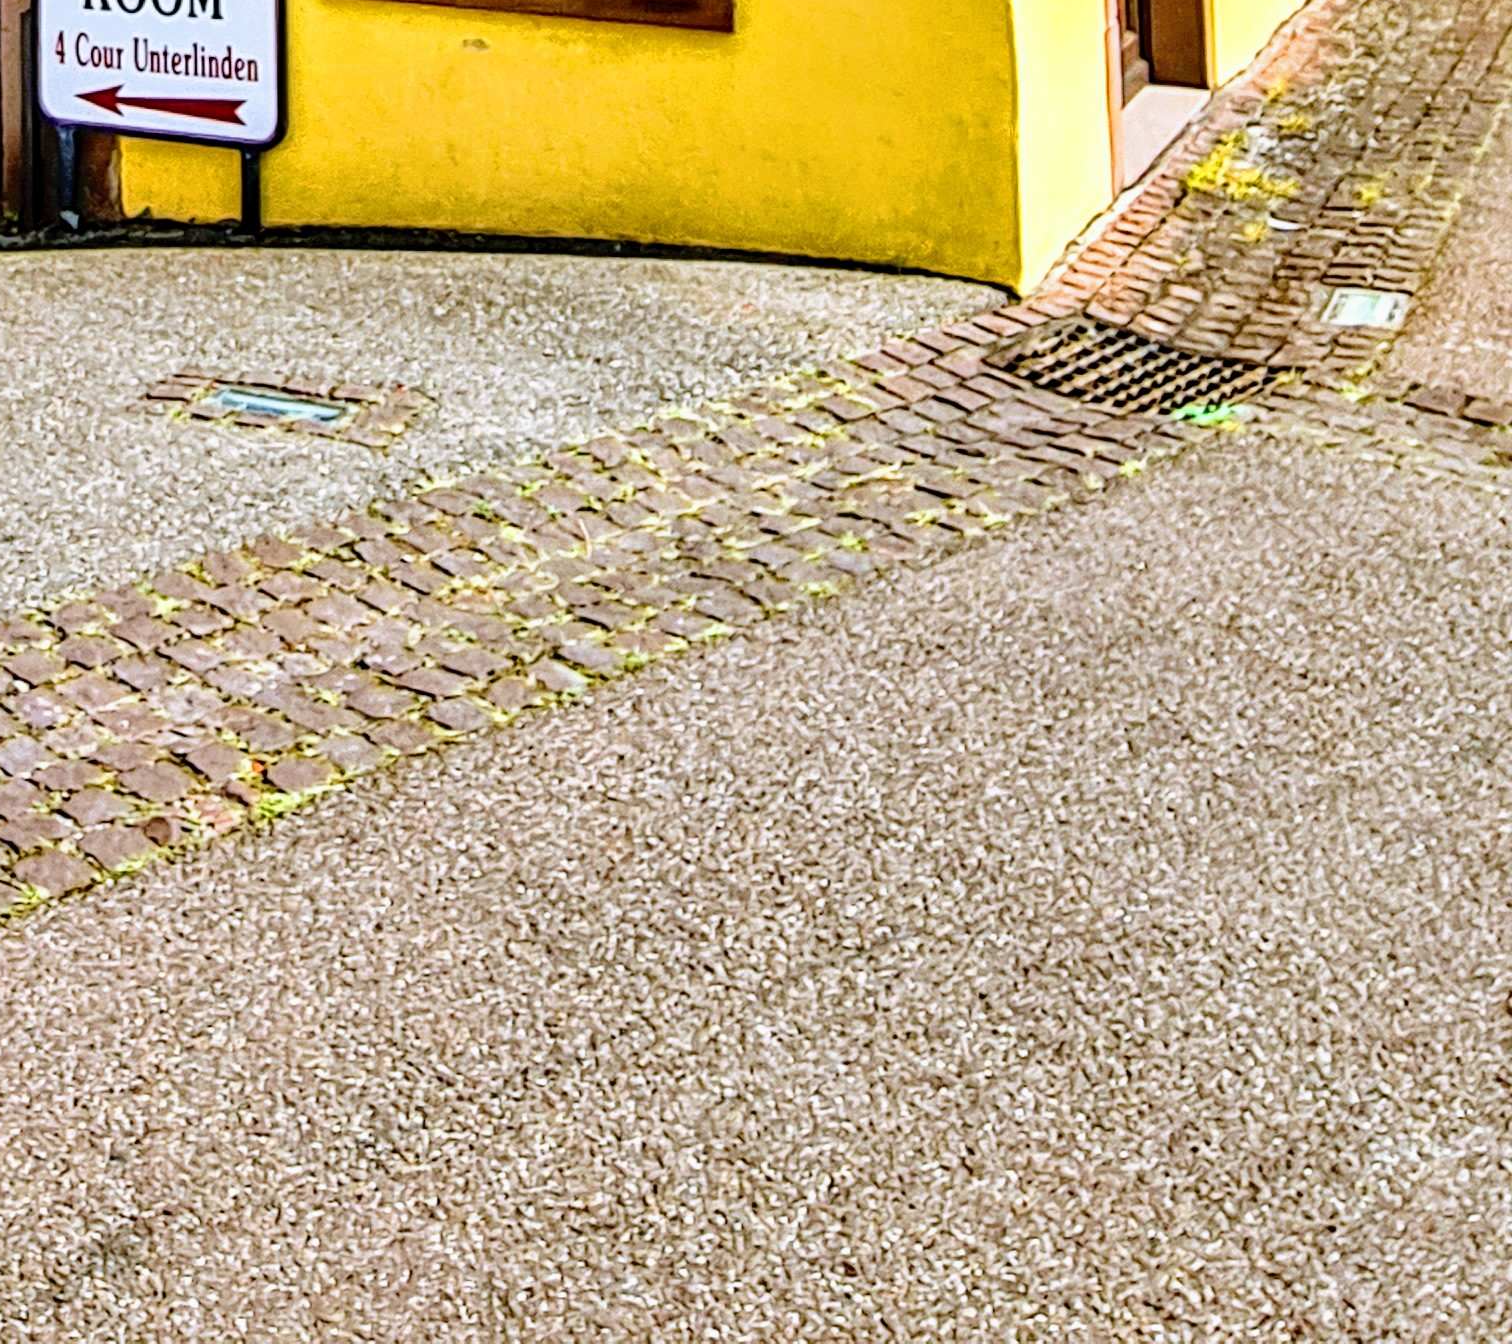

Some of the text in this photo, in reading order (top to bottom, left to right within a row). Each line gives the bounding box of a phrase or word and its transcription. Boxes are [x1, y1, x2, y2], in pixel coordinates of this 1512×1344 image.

[54, 30, 260, 83] 4 Cour Unterlinden
